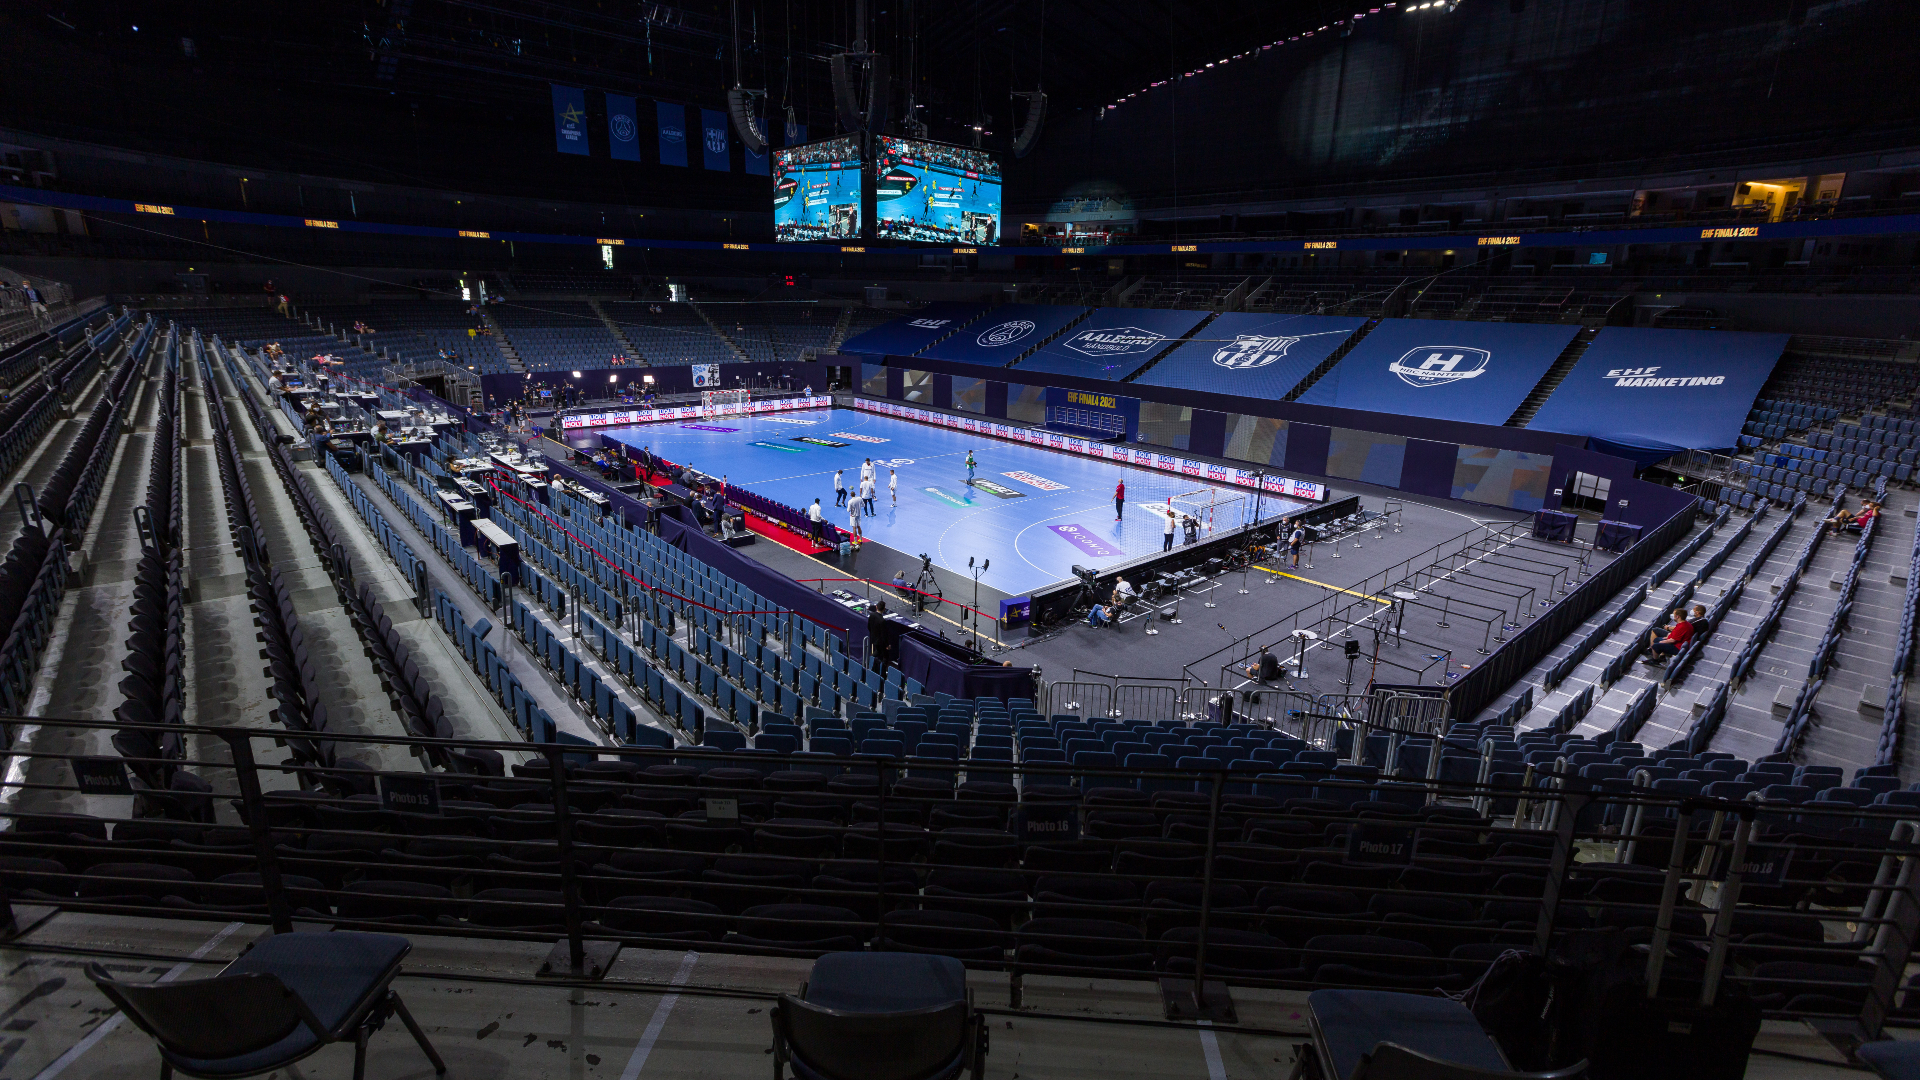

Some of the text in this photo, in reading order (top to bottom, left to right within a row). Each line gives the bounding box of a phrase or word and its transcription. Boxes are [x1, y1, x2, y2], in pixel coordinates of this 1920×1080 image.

[1701, 227, 1759, 238] EHF FINAL4 2021
[1478, 237, 1488, 245] EHF
[1505, 236, 1520, 244] 2021
[911, 318, 951, 326] EHF
[1078, 332, 1158, 346] AALBORG
[1400, 367, 1420, 375] HBC
[1605, 366, 1661, 377] EHF
[1614, 376, 1725, 387] MARKETING
[1067, 391, 1116, 409] EHF FINAL4 2021
[996, 424, 1008, 432] LIQUI
[1013, 427, 1025, 435] LIQUI
[996, 430, 1008, 438] MOLY
[1013, 433, 1025, 441] MOLY
[1030, 430, 1043, 438] LIQUI
[1050, 434, 1063, 442] LIQUI
[1030, 436, 1043, 444] MOLY
[1049, 440, 1063, 449] MOLY
[1069, 438, 1083, 446] LIQUI
[1068, 444, 1083, 452] MOLY
[1089, 442, 1103, 450] LIQUI
[1113, 446, 1128, 455] LIQUI
[1089, 448, 1103, 457] MOLY
[1113, 453, 1128, 461] MOLY
[1135, 450, 1151, 459] LIQUI
[1135, 457, 1151, 466] MOLY
[1158, 455, 1175, 464] LIQUI
[1183, 459, 1200, 469] LIQUI
[1158, 461, 1175, 471] MOLY
[1208, 465, 1226, 474] LIQUI
[1182, 466, 1199, 476] MOLY
[1207, 471, 1226, 481] MOLY
[1236, 477, 1255, 486] MOLY
[1295, 481, 1316, 491] LIQUI
[1264, 482, 1285, 492] MOLY
[1294, 488, 1316, 498] MOLY
[84, 775, 120, 786] Photo 14
[390, 791, 429, 805] Photo 15
[1027, 820, 1069, 832] Photo 16
[1360, 841, 1404, 855] Photo 17
[1760, 862, 1774, 874] 18
